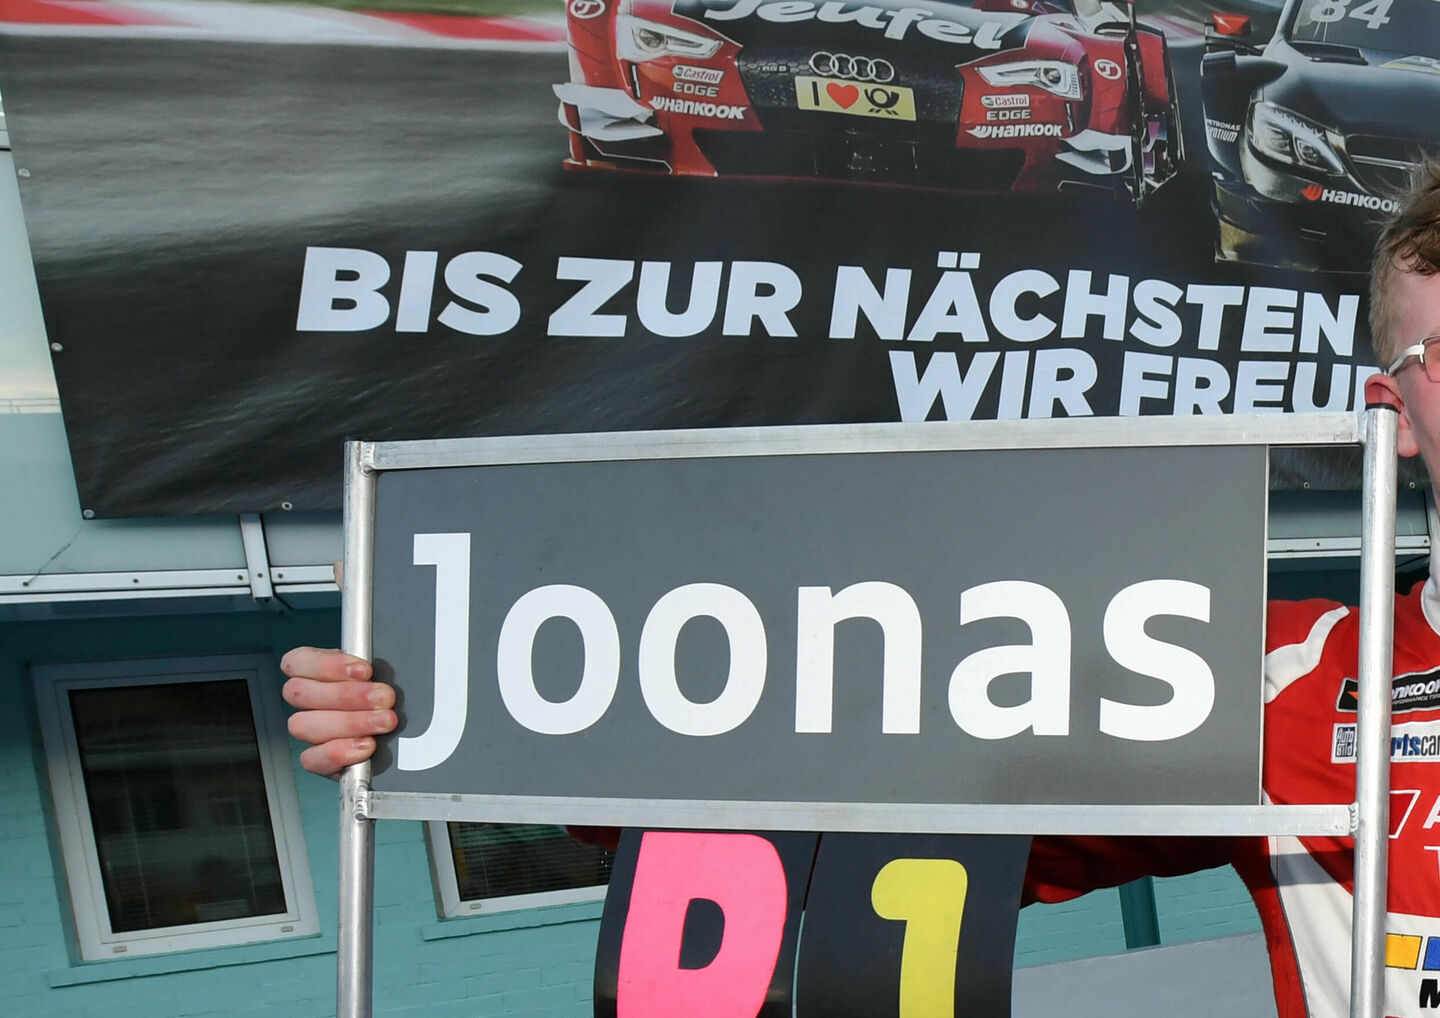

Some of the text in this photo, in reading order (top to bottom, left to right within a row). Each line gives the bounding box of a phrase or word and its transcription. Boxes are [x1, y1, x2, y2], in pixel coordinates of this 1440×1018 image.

[683, 68, 721, 83] Castrol
[673, 82, 720, 98] EDGE
[994, 95, 1028, 107] Castrol
[986, 109, 1032, 121] EDGE
[296, 246, 1360, 357] BIS ZUR NÄCHSTEN
[888, 348, 1099, 422] WIR
[396, 532, 1216, 772] Joonas
